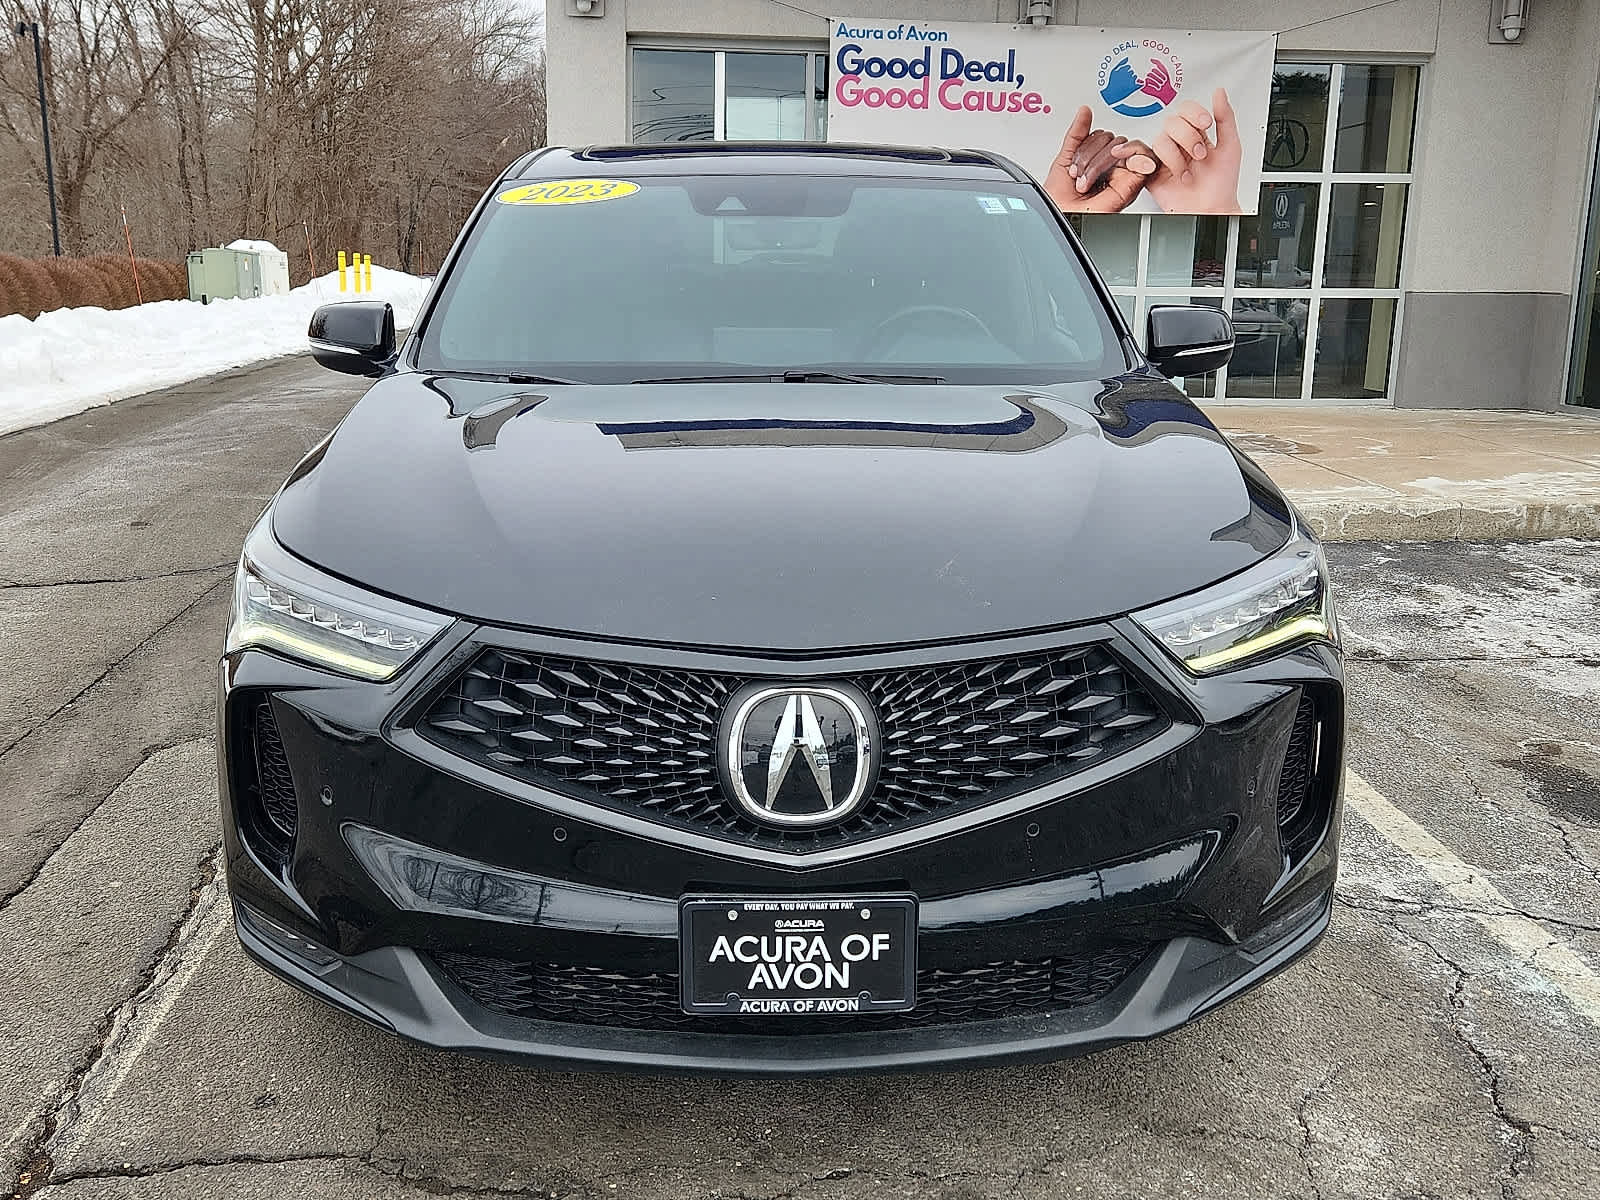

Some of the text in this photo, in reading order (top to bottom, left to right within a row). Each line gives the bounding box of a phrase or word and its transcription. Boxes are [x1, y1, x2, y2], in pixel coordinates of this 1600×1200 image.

[836, 22, 948, 42] Acura of Avon
[836, 44, 1025, 90] Good Deal,
[1098, 39, 1183, 89] GOOD DEAL, GOOD CAUSE
[835, 74, 1052, 114] Good Cause.
[519, 183, 618, 201] 2023
[781, 903, 795, 911] YOU
[784, 920, 824, 928] ACURA
[708, 934, 890, 963] ACURA OF
[747, 962, 850, 990] AVON
[739, 1000, 859, 1013] ACURA OF AVON
